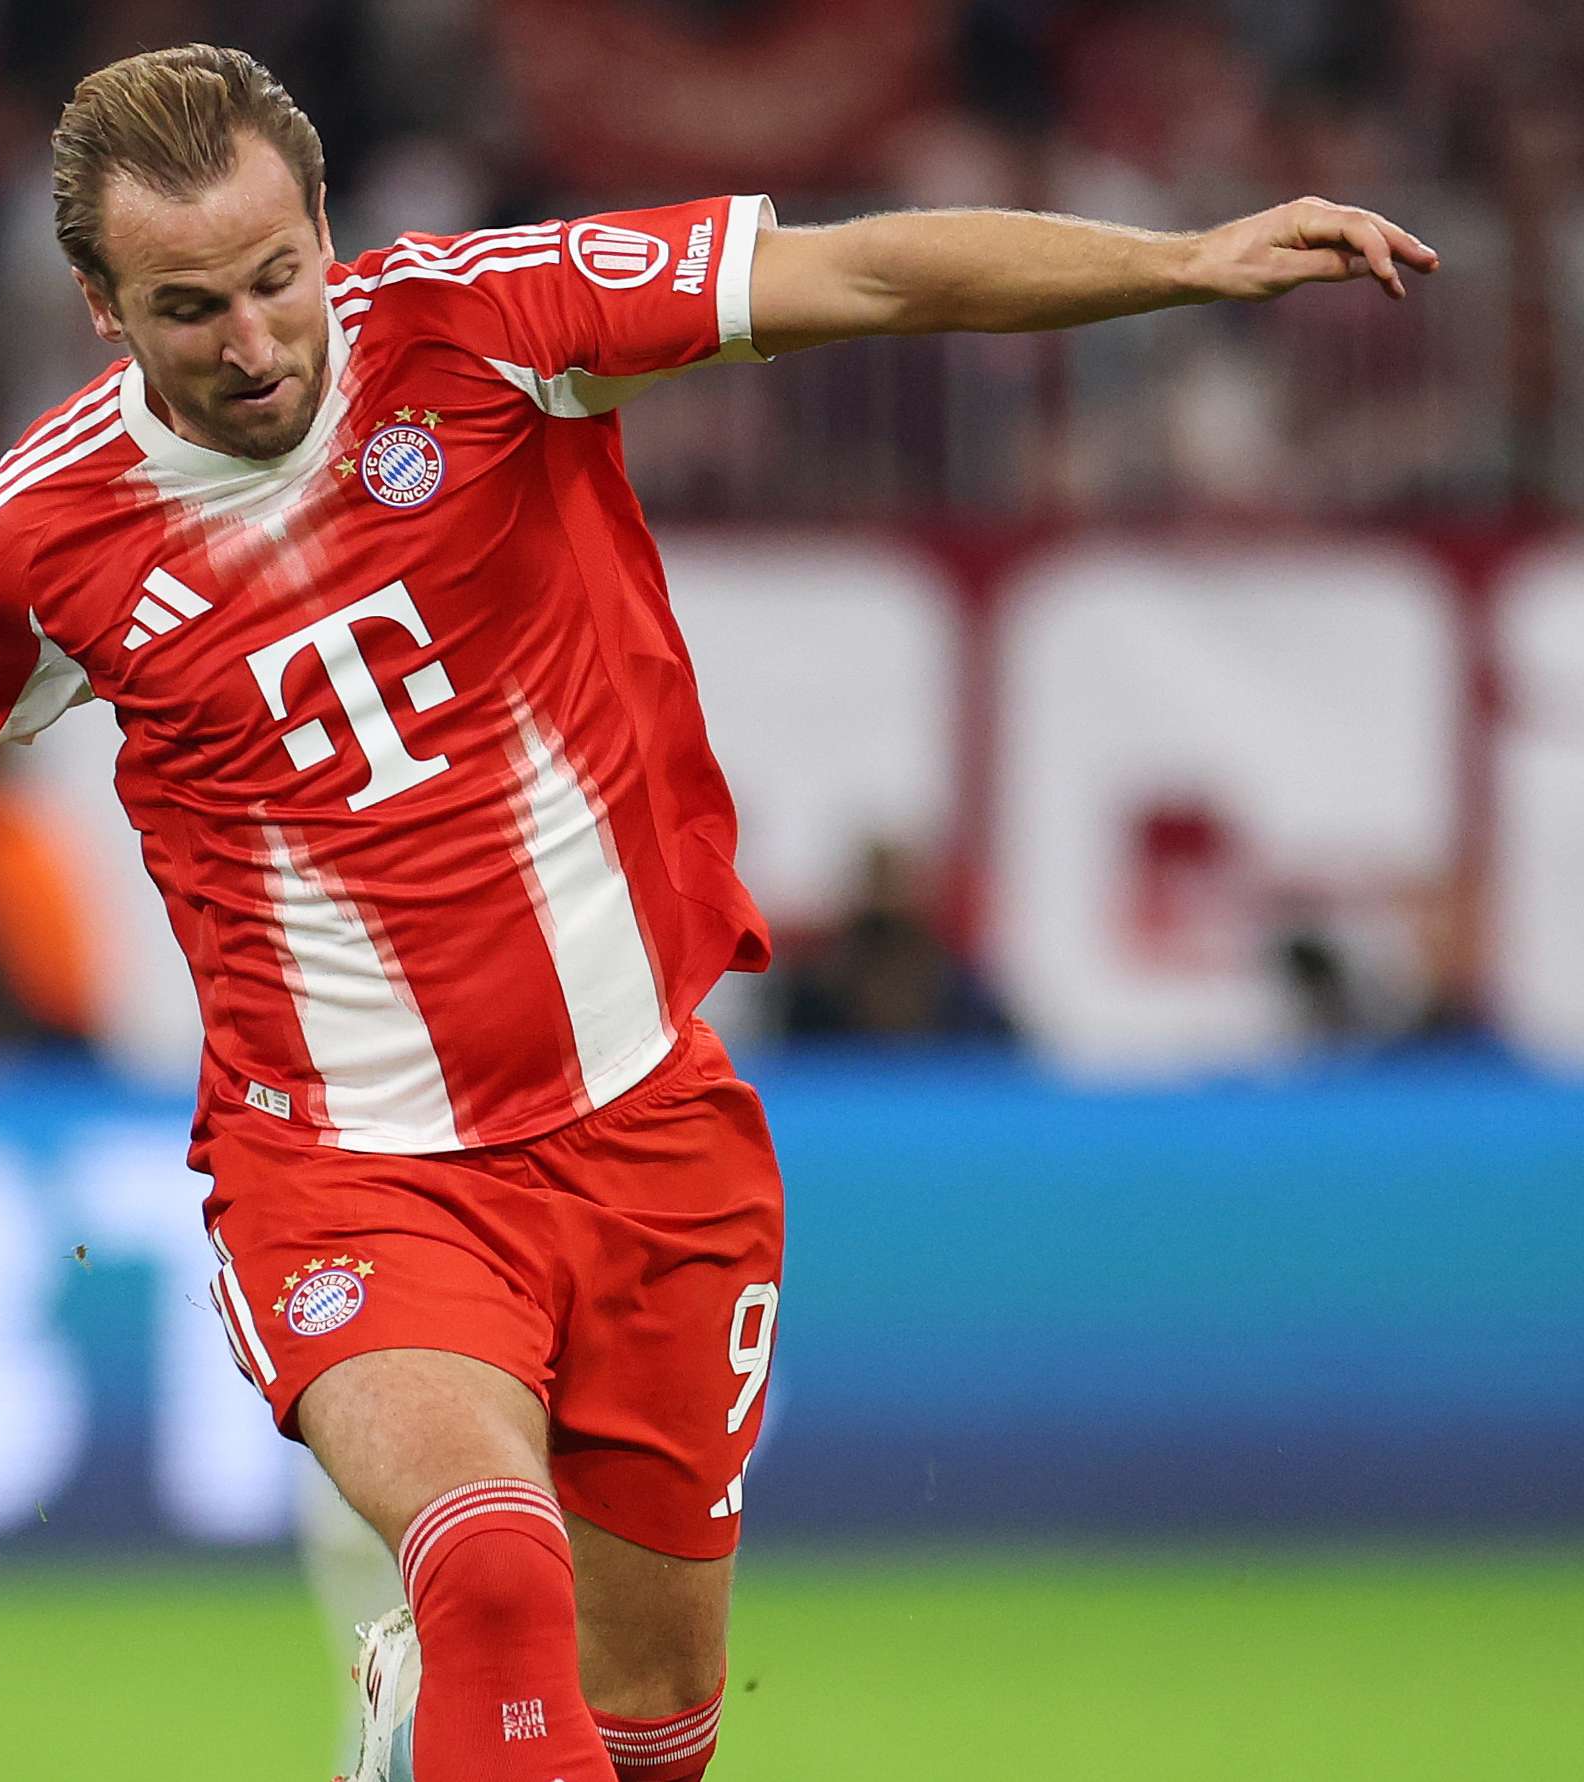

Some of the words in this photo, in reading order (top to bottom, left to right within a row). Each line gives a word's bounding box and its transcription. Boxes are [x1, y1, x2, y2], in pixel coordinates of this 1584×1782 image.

[672, 217, 713, 295] Allianz
[367, 457, 378, 476] FC
[375, 431, 428, 455] BAYERN
[245, 579, 457, 813] T
[304, 1275, 355, 1296] BAYERN
[727, 1281, 779, 1434] 9
[502, 1698, 543, 1717] MIA
[505, 1725, 548, 1742] MIA
